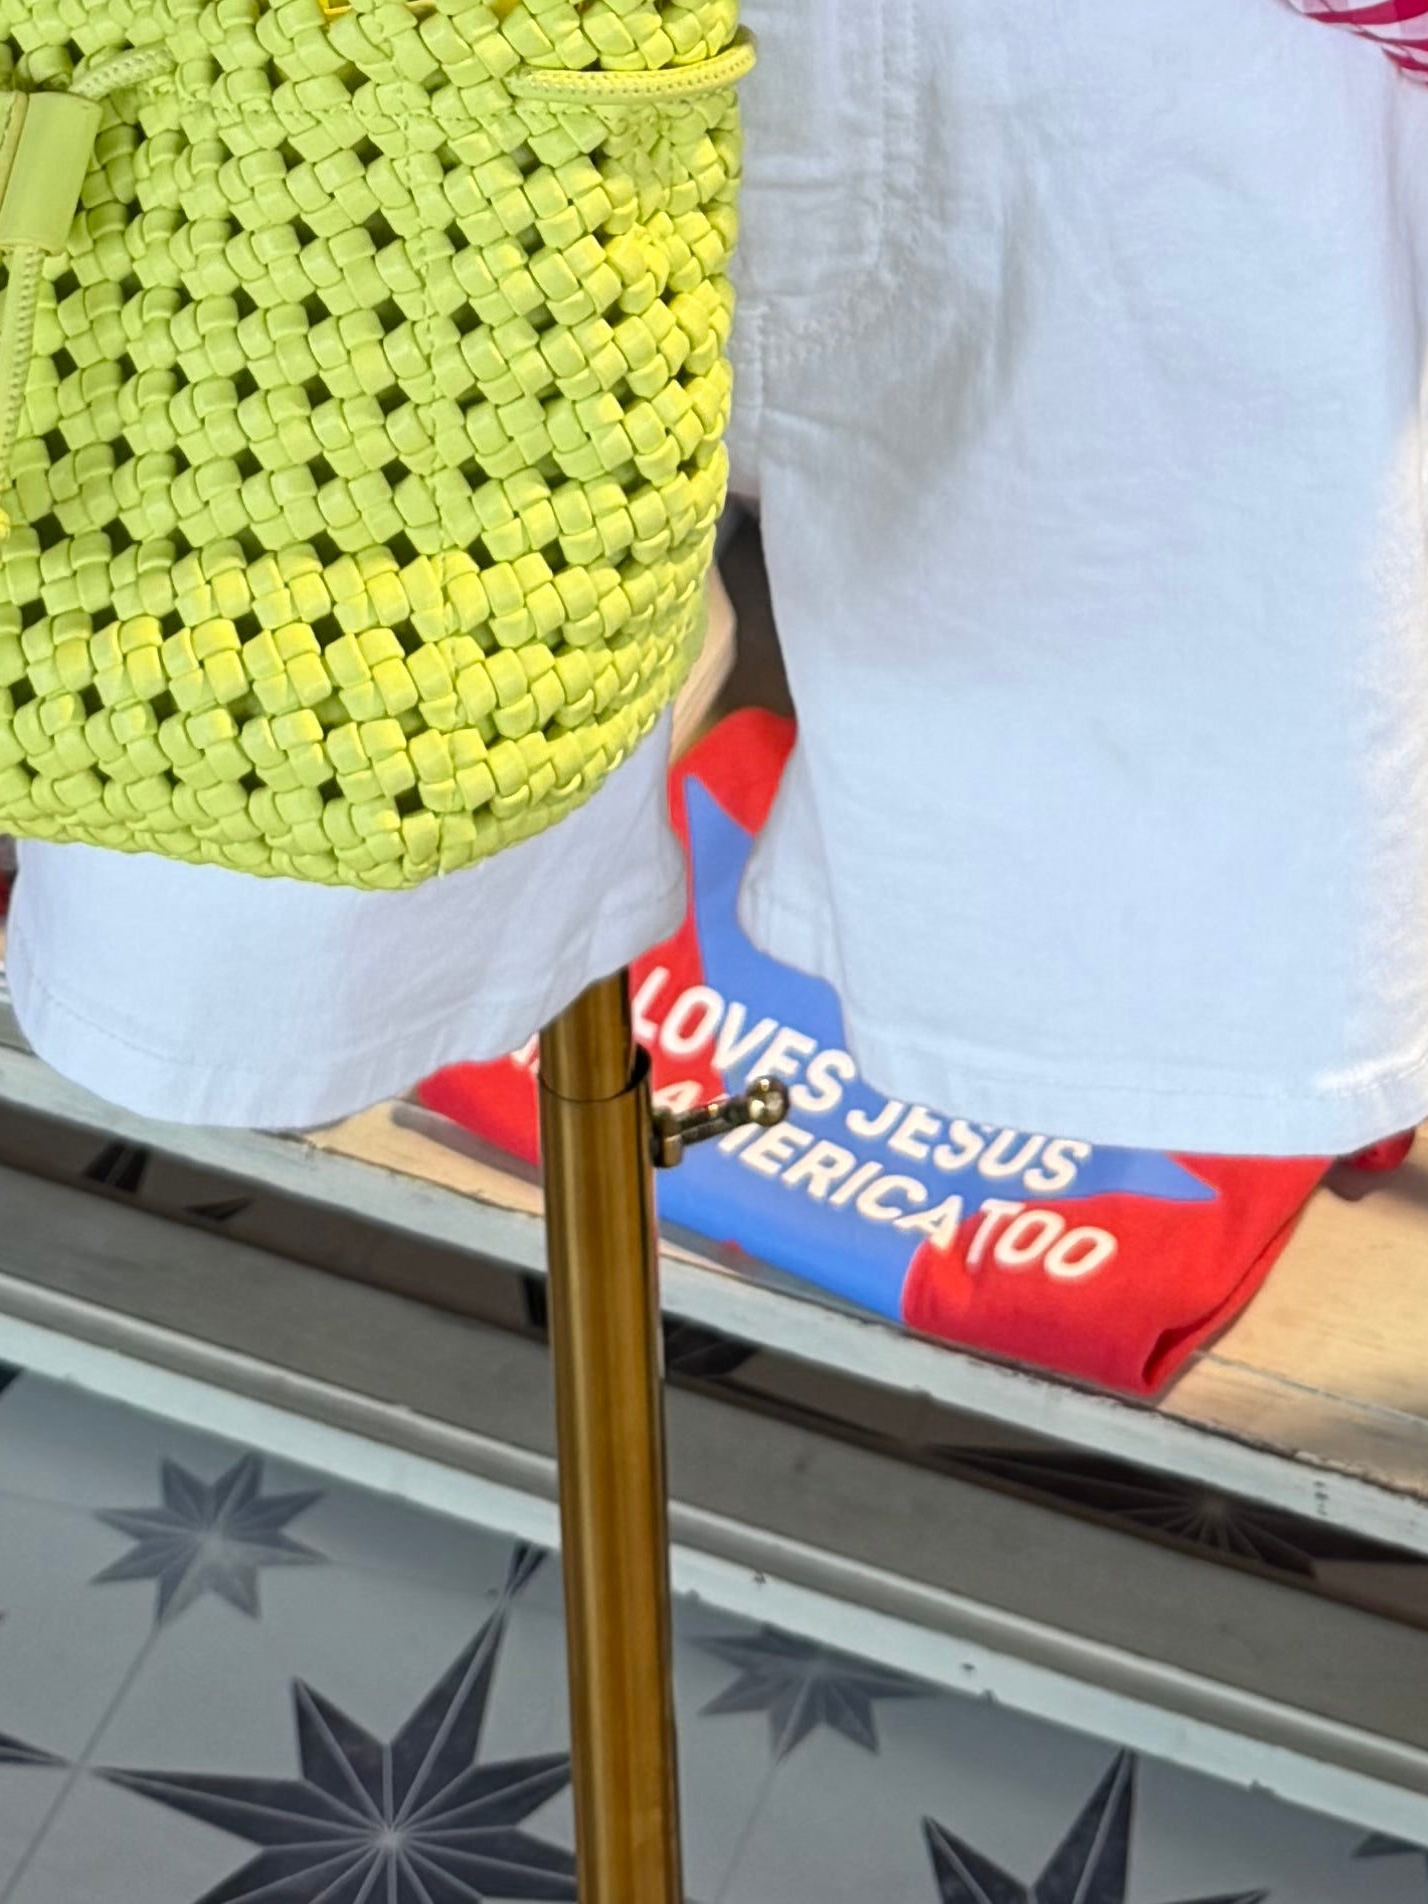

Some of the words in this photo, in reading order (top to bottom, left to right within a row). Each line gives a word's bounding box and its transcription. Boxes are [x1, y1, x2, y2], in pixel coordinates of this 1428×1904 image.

[632, 966, 857, 1114] LOVES
[845, 1099, 1093, 1192] JESUS
[653, 1079, 964, 1253] AERICA
[965, 1197, 1119, 1281] TOO
